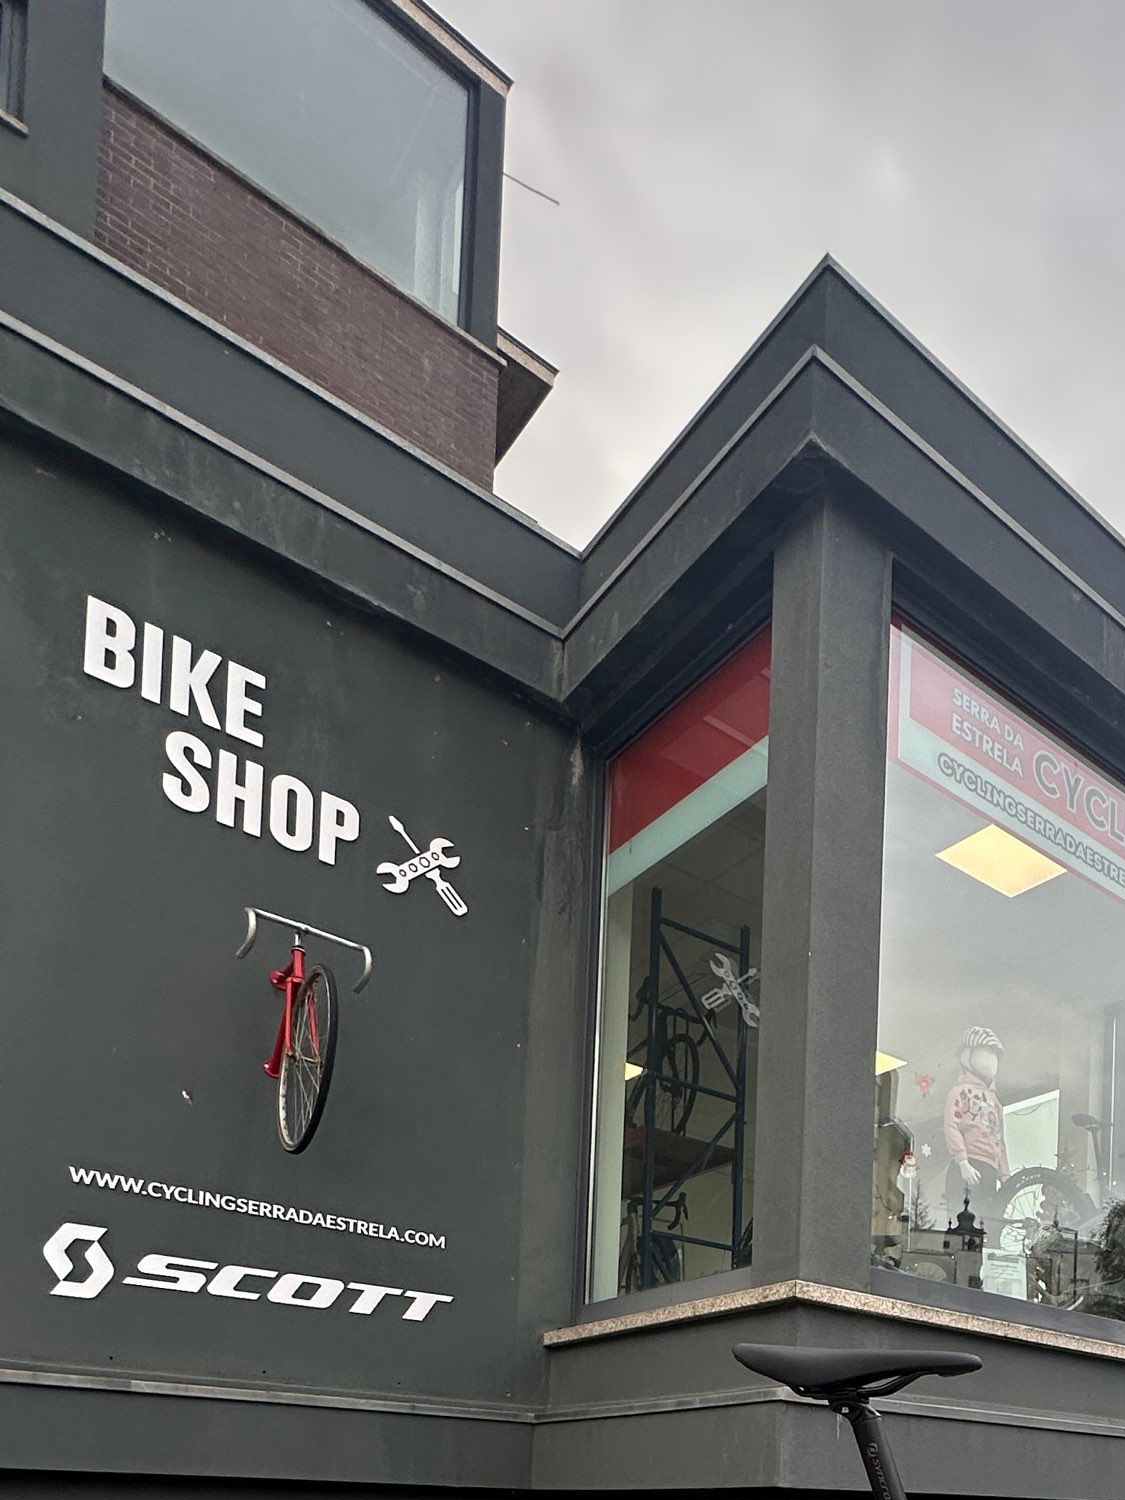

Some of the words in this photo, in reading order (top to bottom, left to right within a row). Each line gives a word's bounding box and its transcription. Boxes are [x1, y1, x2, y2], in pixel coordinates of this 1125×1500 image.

[84, 594, 267, 748] BIKE
[952, 712, 1024, 779] ESTRELA
[953, 687, 1001, 735] SERRA
[1004, 723, 1025, 751] DA
[162, 730, 360, 866] SHOP
[68, 1166, 447, 1249] WWW.CYCLINGSERRADAESTRELA.COM
[122, 1253, 455, 1322] SCOTT
